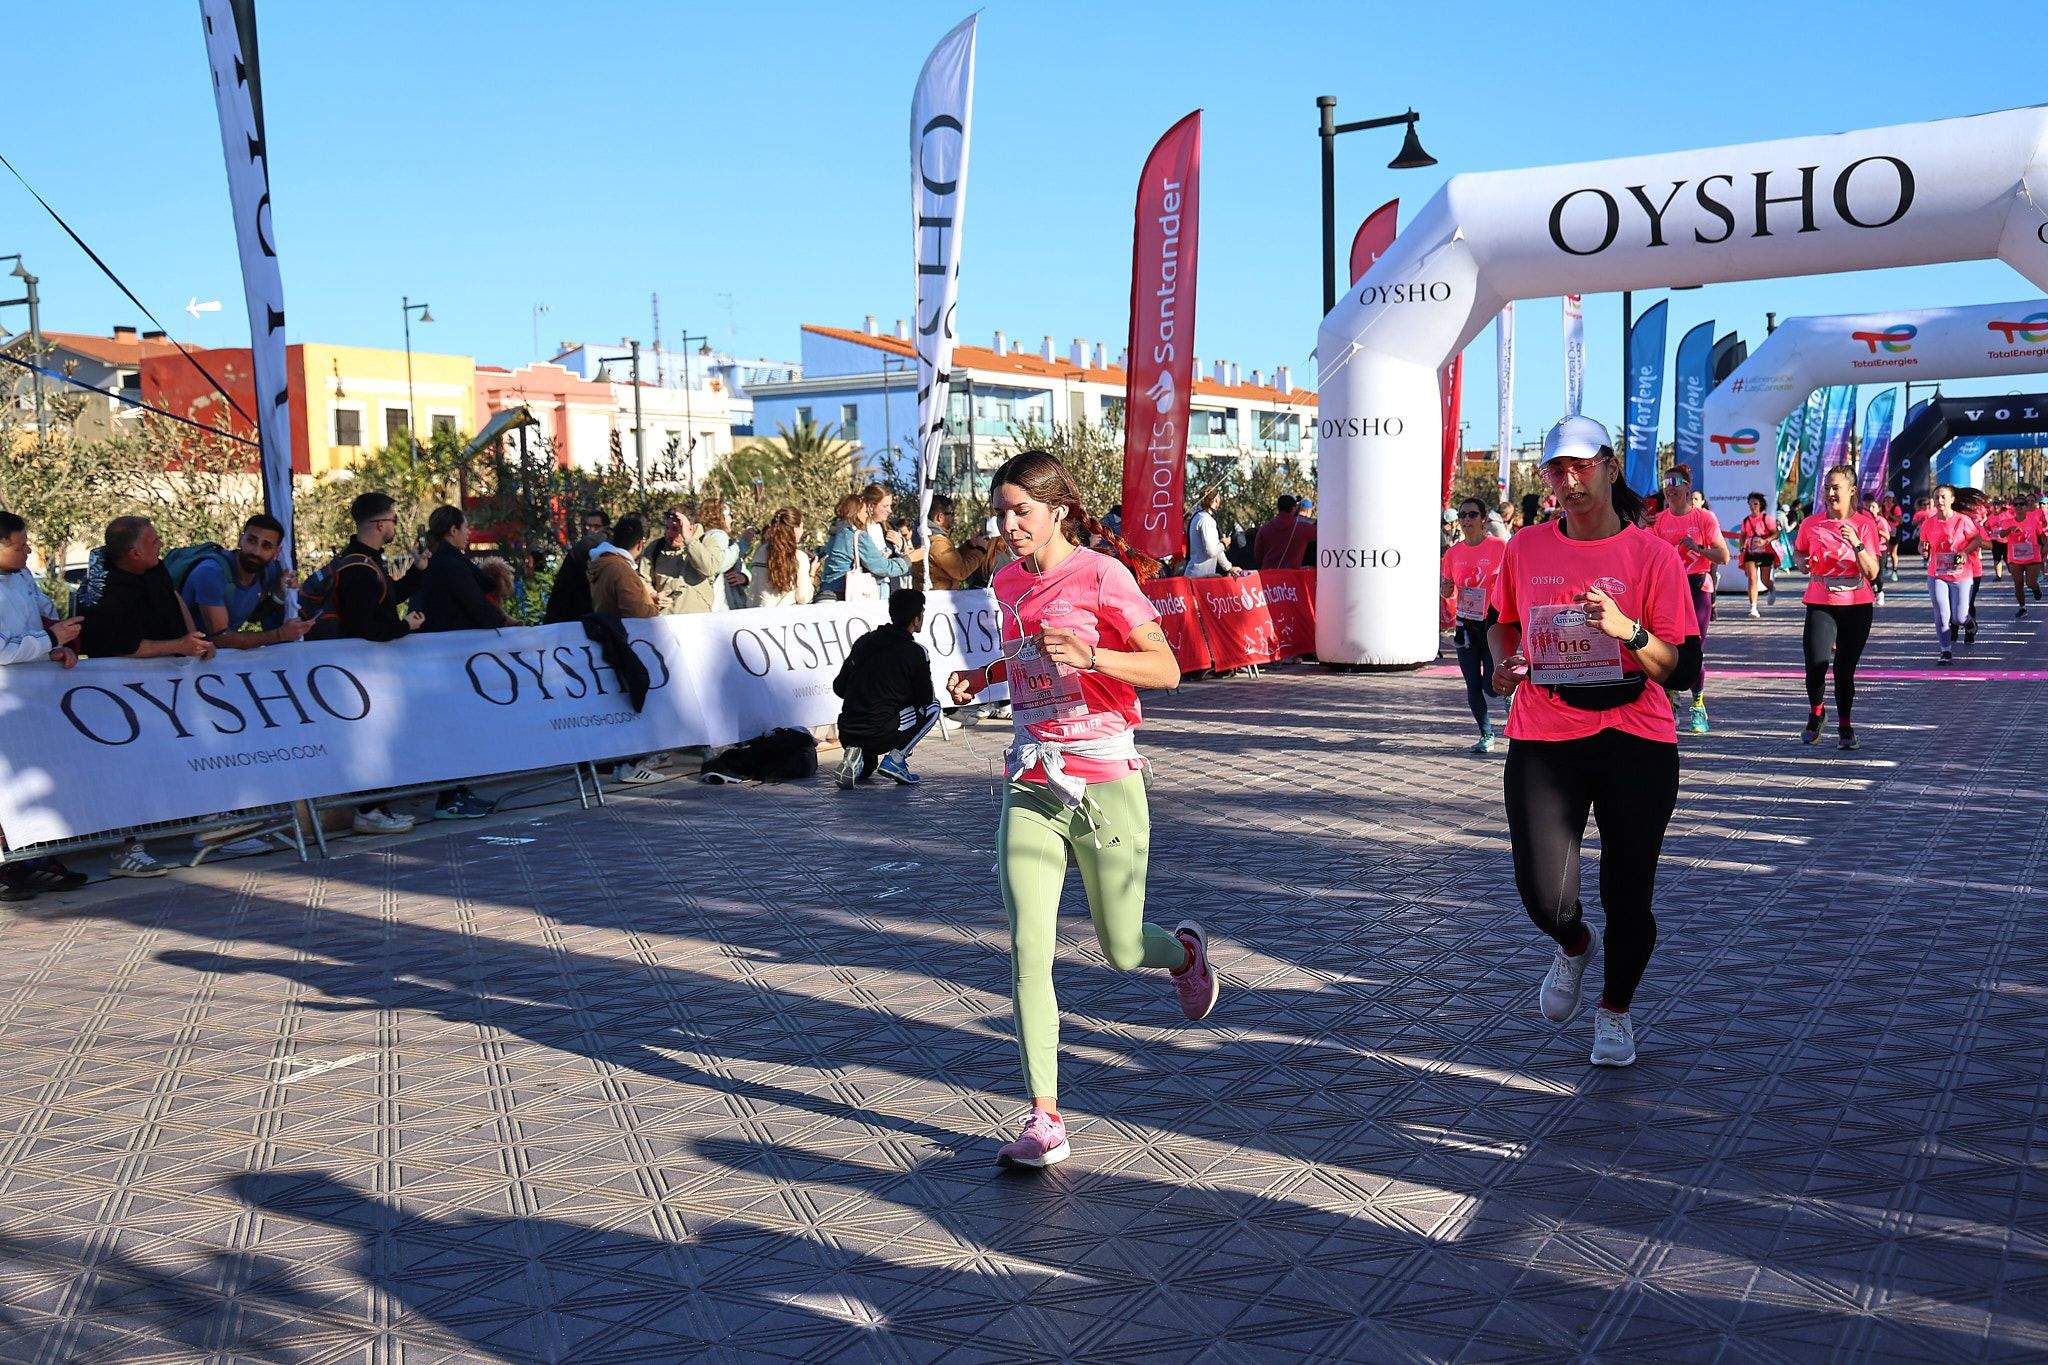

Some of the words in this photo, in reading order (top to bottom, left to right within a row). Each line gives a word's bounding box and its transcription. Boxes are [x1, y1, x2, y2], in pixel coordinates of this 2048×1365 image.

[1548, 155, 1916, 256] OYSHO
[1154, 178, 1181, 364] Santander
[1360, 282, 1451, 306] OYSHO
[1852, 357, 1918, 368] TotalEnergies
[1629, 365, 1658, 451] Marlene
[1677, 375, 1706, 455] Marlene
[1322, 417, 1404, 439] OYSHO
[1145, 420, 1175, 531] Sports
[1710, 459, 1760, 468] TotalEnergies
[1902, 459, 1911, 541] VOLVO
[1320, 549, 1402, 569] OYSHO
[1531, 576, 1565, 585] OYSHO
[1206, 592, 1242, 619] Sports
[1250, 582, 1298, 608] Santander
[1557, 639, 1591, 653] 016
[465, 639, 669, 705] OYSHO
[60, 664, 370, 745] OYSHO
[187, 744, 328, 772] WWW.OYSHO.COM
